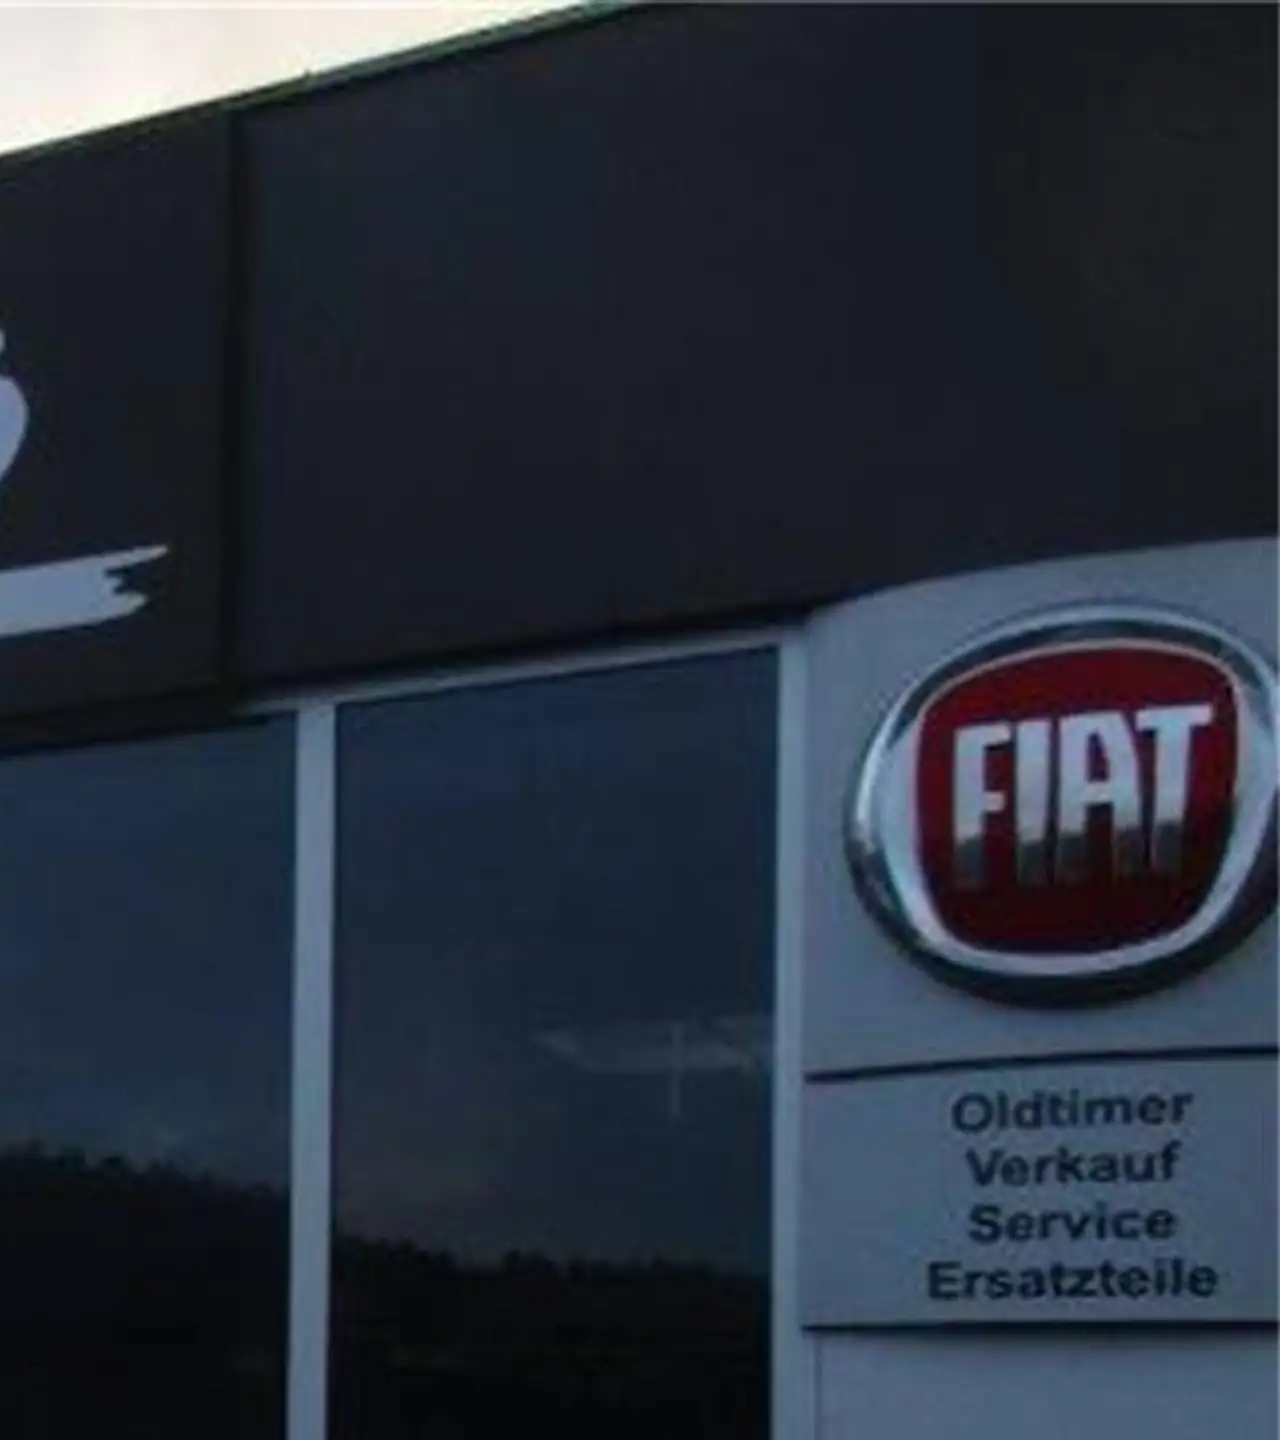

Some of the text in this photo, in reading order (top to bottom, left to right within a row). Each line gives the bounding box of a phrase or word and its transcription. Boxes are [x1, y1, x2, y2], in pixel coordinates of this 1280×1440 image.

[952, 704, 1213, 888] FIAT
[951, 1089, 1193, 1133] Oldtimer
[965, 1143, 1183, 1188] Verkauf
[968, 1204, 1177, 1244] Service
[928, 1258, 1219, 1300] Ersatzteile
